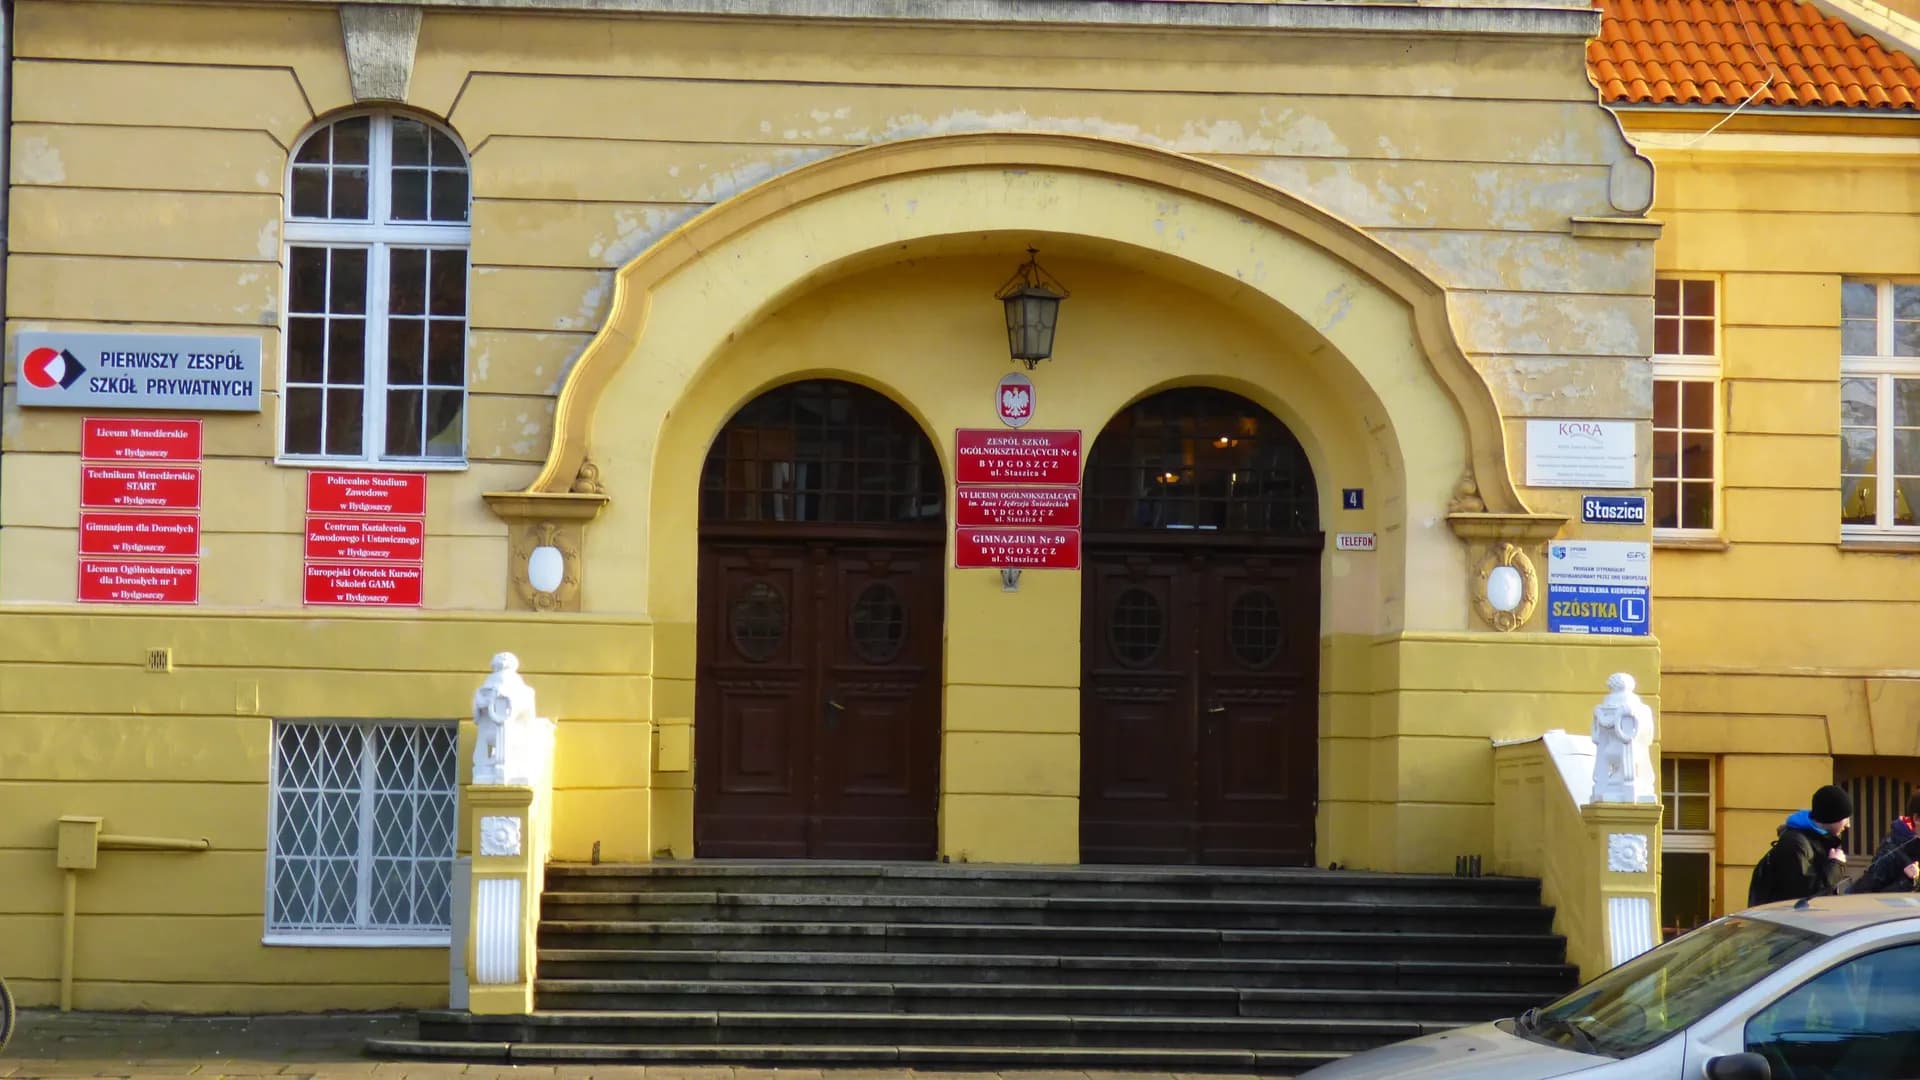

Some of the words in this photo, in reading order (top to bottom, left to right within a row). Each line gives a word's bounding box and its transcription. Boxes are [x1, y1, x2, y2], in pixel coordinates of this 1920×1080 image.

[100, 352, 178, 369] PIERWSZY
[187, 350, 244, 370] ZESPÓŁ
[90, 374, 138, 394] SZKÓŁ
[146, 379, 252, 396] PRYWATNYCH
[97, 428, 127, 437] Liceum
[131, 429, 188, 438] Menedżerskie
[1560, 424, 1602, 436] KORA
[125, 448, 168, 458] Bydgoszczy
[980, 460, 1058, 468] BYDGOSZCZ
[88, 470, 134, 479] Technikum
[138, 471, 195, 480] Menedżerskie
[127, 482, 157, 490] START
[328, 476, 369, 485] Policealne
[372, 478, 407, 486] Studium
[345, 488, 388, 496] Zawodowe
[123, 496, 167, 505] Bydgoszczy
[1350, 492, 1357, 507] 4
[349, 502, 392, 512] Bydgoszczy
[1586, 501, 1643, 520] Staszica
[86, 523, 133, 532] Gimnazjum
[136, 524, 149, 532] dla
[152, 524, 194, 534] Dorosłych
[325, 522, 359, 531] Centrum
[362, 523, 406, 532] Kształcenia
[310, 533, 359, 543] Zawodowego
[368, 535, 419, 544] Ustawicznego
[972, 535, 1035, 544] GIMNAZJUM
[1040, 536, 1050, 544] Nr
[1055, 536, 1065, 544] 50
[1340, 536, 1373, 546] TELEFON
[122, 543, 165, 552] Bydgoszczy
[347, 548, 390, 557] Bydgoszczy
[87, 564, 117, 573] Liceum
[120, 565, 192, 575] Ogólnokształcące
[308, 568, 350, 577] Europejski
[353, 568, 386, 577] Ośrodek
[389, 569, 419, 578] Kursów
[100, 576, 113, 584] dla
[116, 576, 157, 586] Dorosłych
[336, 580, 366, 588] Szkoleń
[369, 580, 395, 588] GAMA
[121, 591, 164, 600] Bydgoszczy
[346, 593, 389, 602] Bydgoszczy
[1552, 598, 1618, 618] SZÓSTKA
[1627, 600, 1639, 620] L
